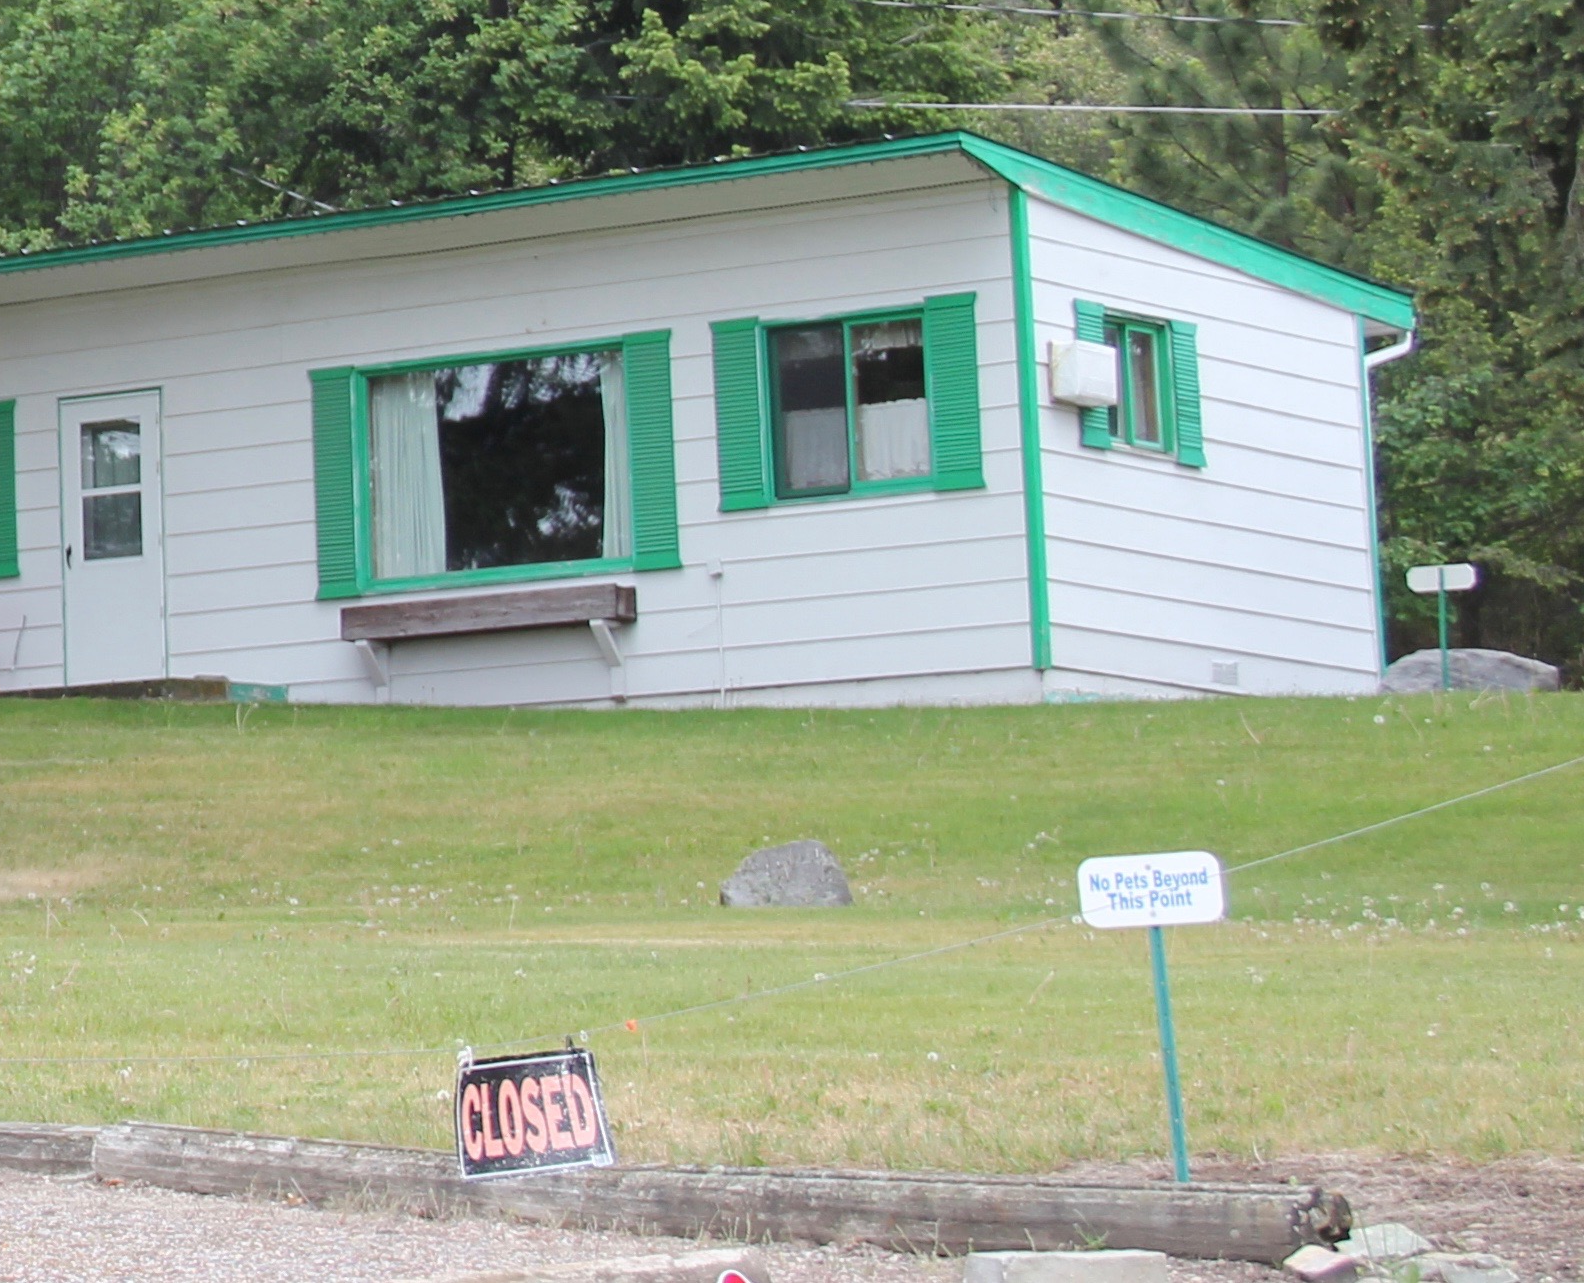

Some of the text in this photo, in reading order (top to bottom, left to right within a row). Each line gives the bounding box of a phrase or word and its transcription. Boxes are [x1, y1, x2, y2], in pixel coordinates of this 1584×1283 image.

[1088, 867, 1208, 892] No Pets Beyond
[1107, 889, 1194, 911] This Point
[461, 1072, 598, 1162] CLOSED
